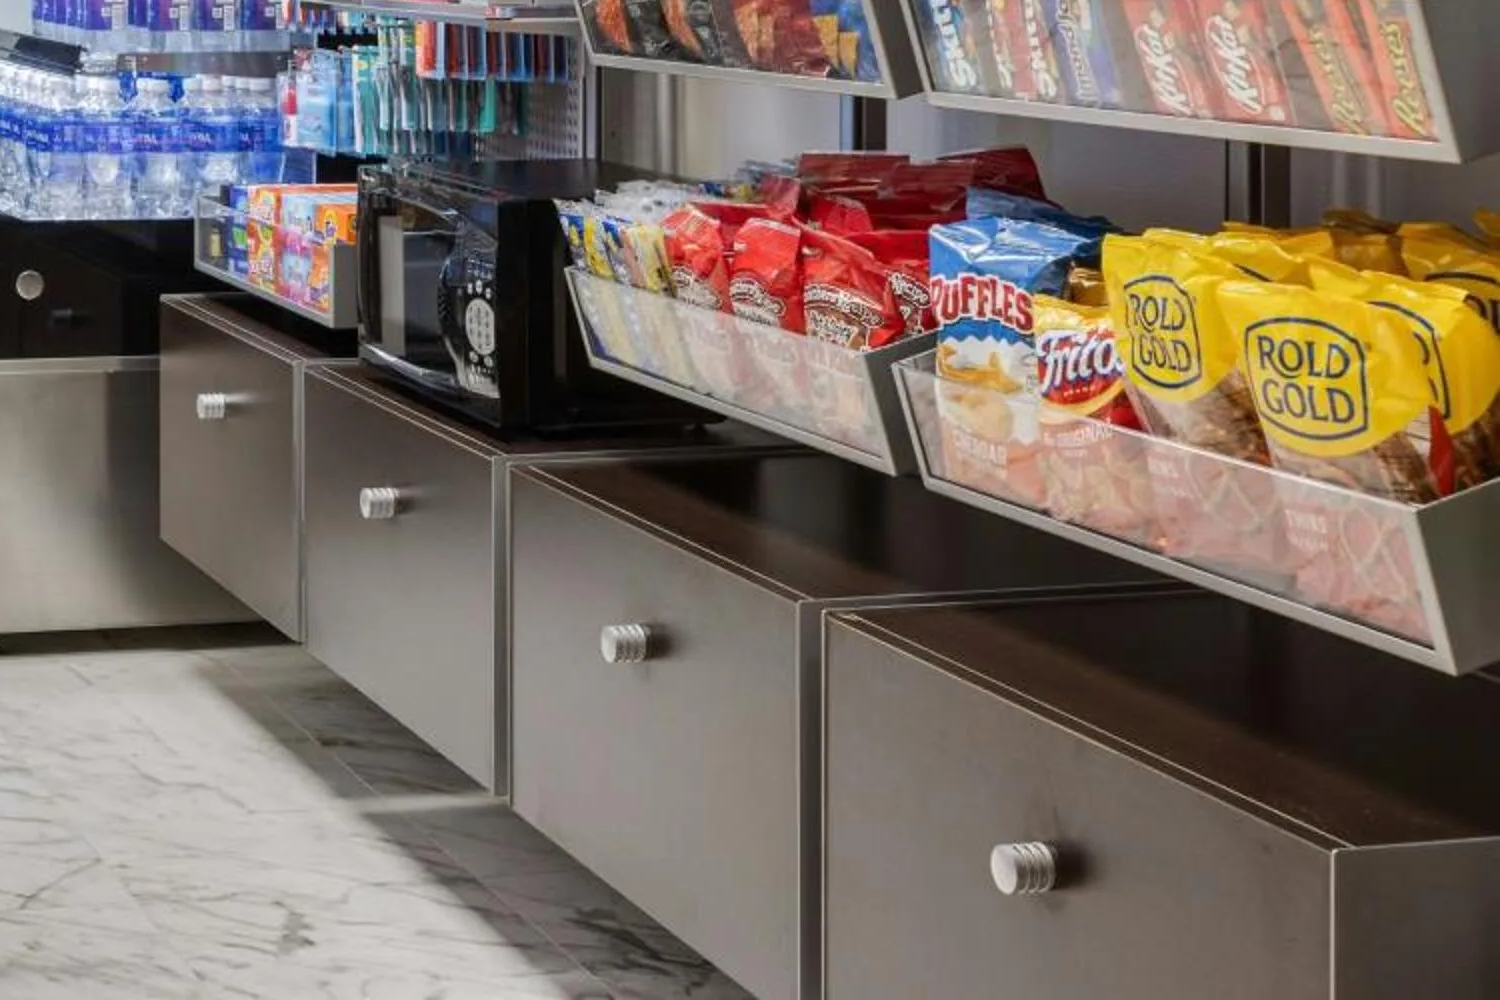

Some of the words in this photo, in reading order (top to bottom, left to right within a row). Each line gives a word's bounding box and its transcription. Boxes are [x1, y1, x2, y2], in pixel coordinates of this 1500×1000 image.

[1127, 293, 1187, 332] ROLD
[1139, 338, 1192, 373] GOLD
[1257, 334, 1351, 380] ROLD
[1261, 378, 1355, 424] GOLD
